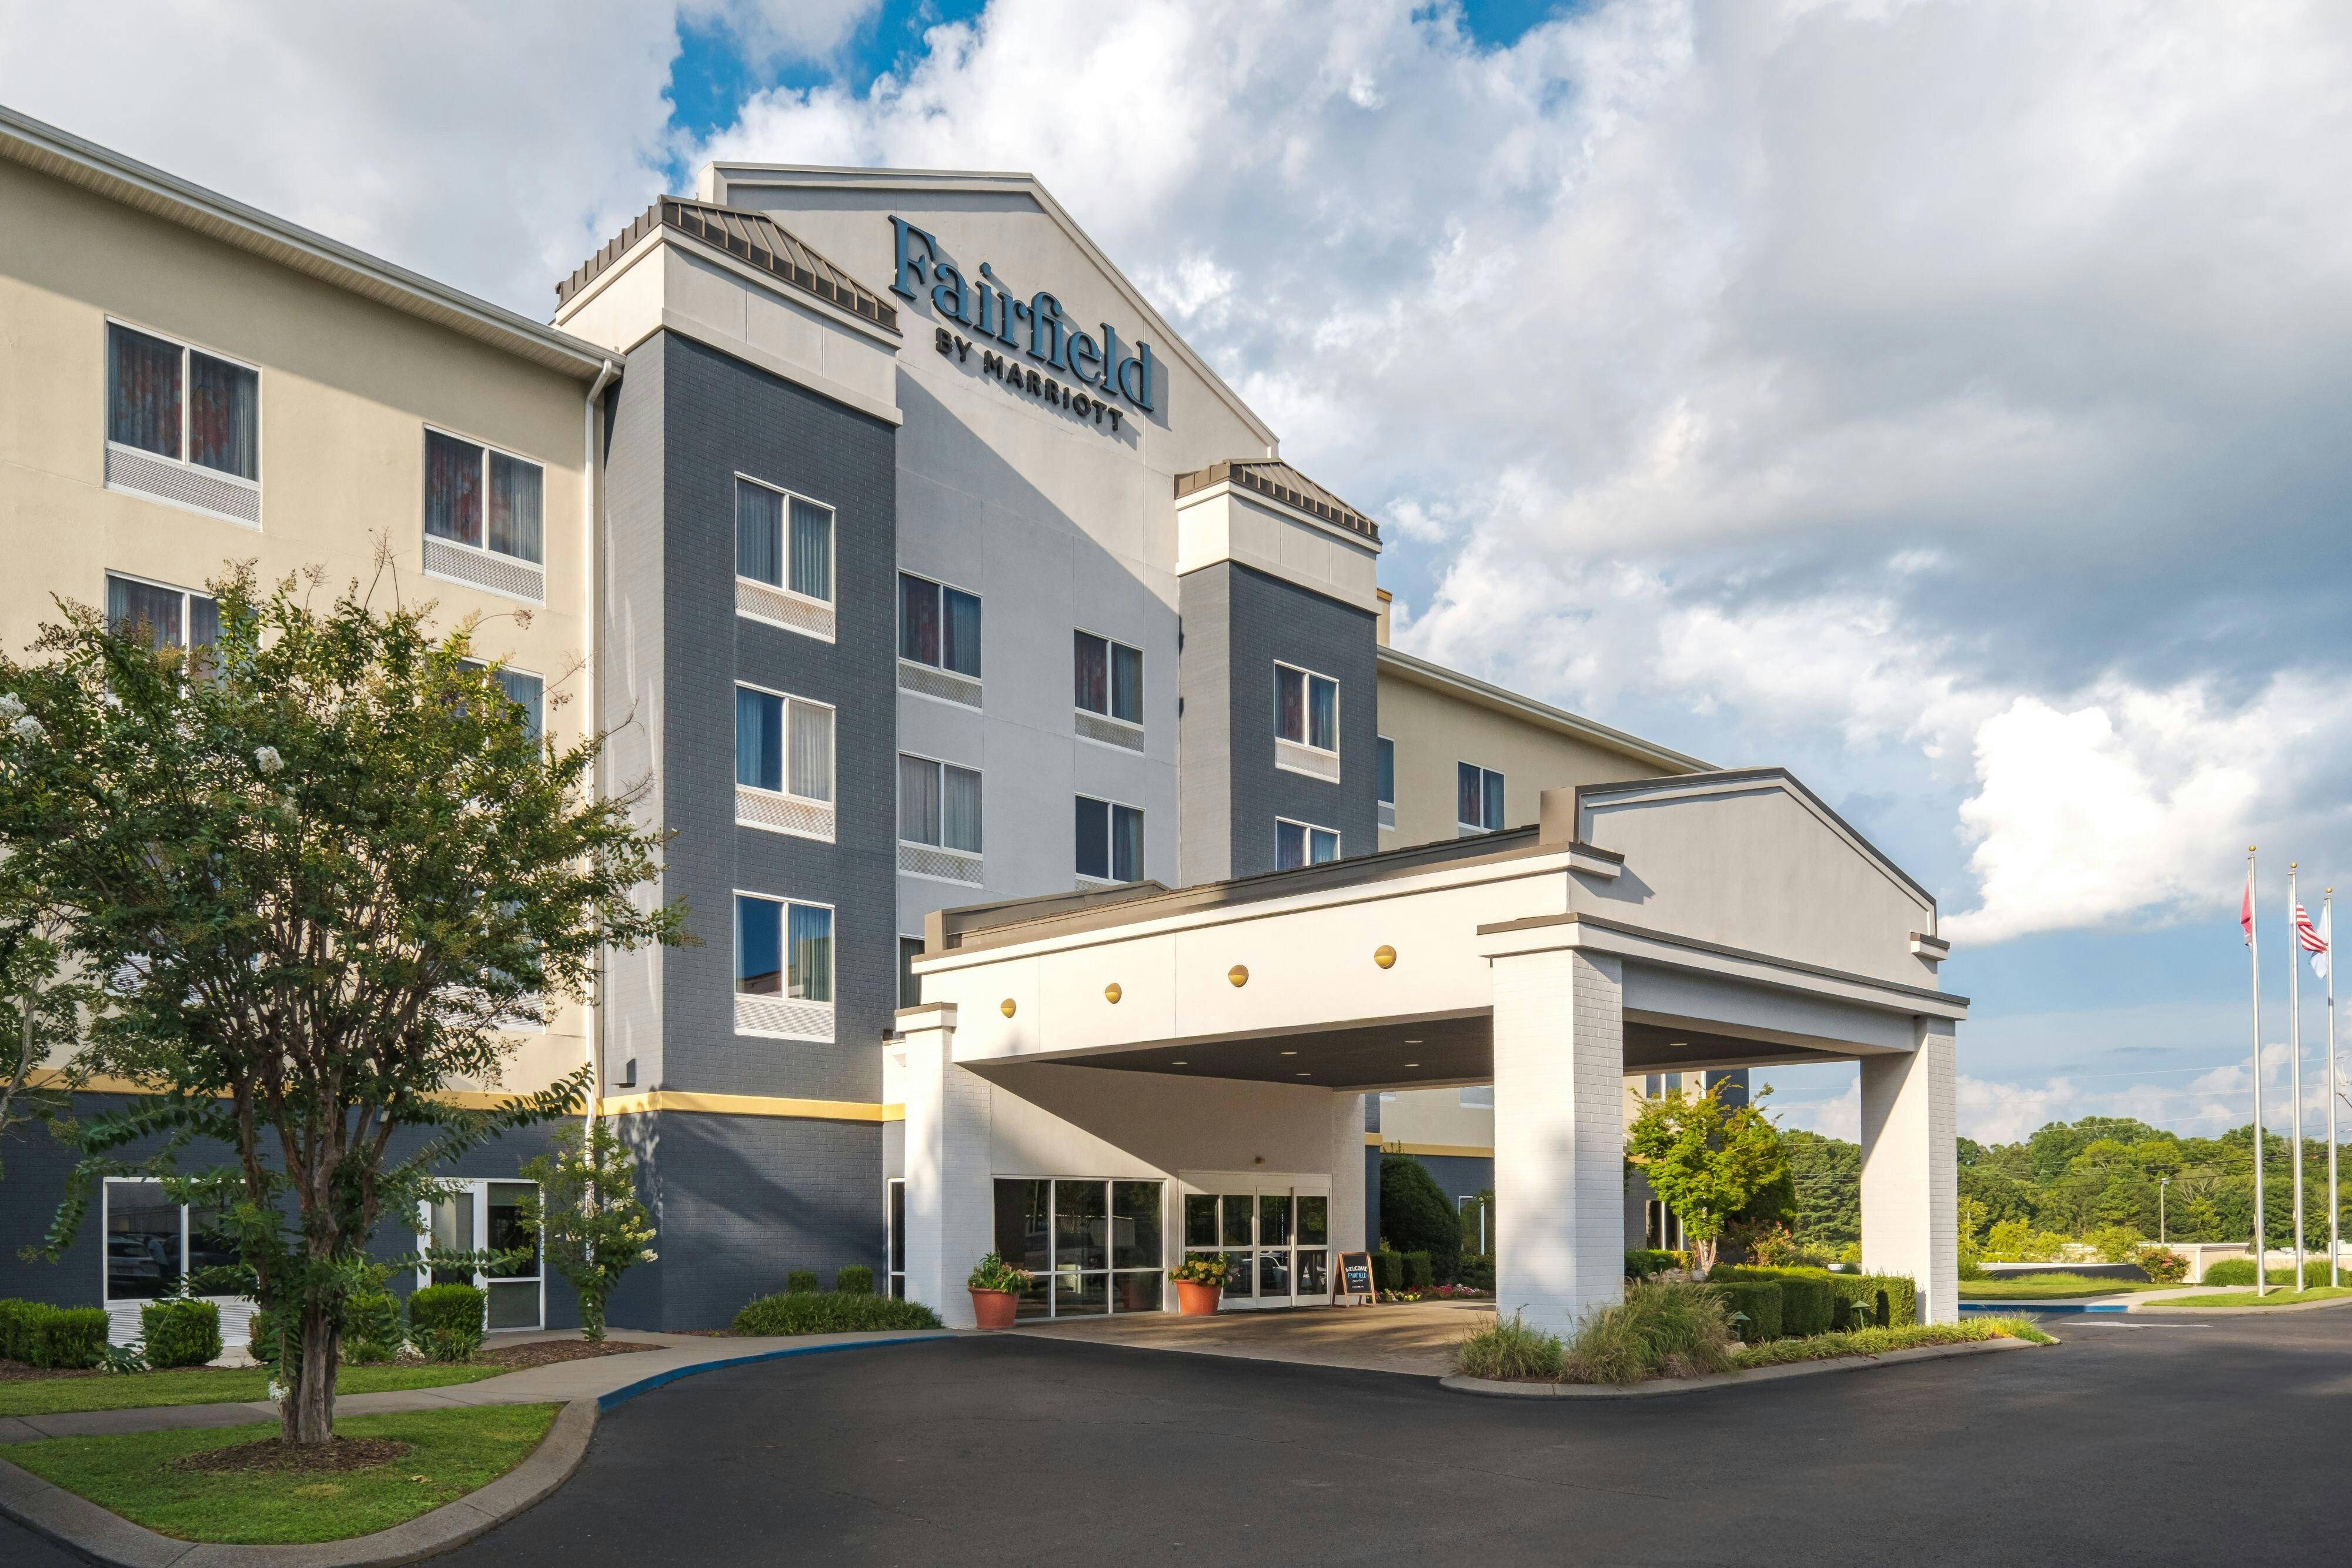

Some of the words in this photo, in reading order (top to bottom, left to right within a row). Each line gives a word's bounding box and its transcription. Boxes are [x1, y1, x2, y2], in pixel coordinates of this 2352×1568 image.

[887, 215, 1154, 412] Fairfield
[936, 327, 973, 362] BY
[984, 350, 1124, 431] MARRIOTT
